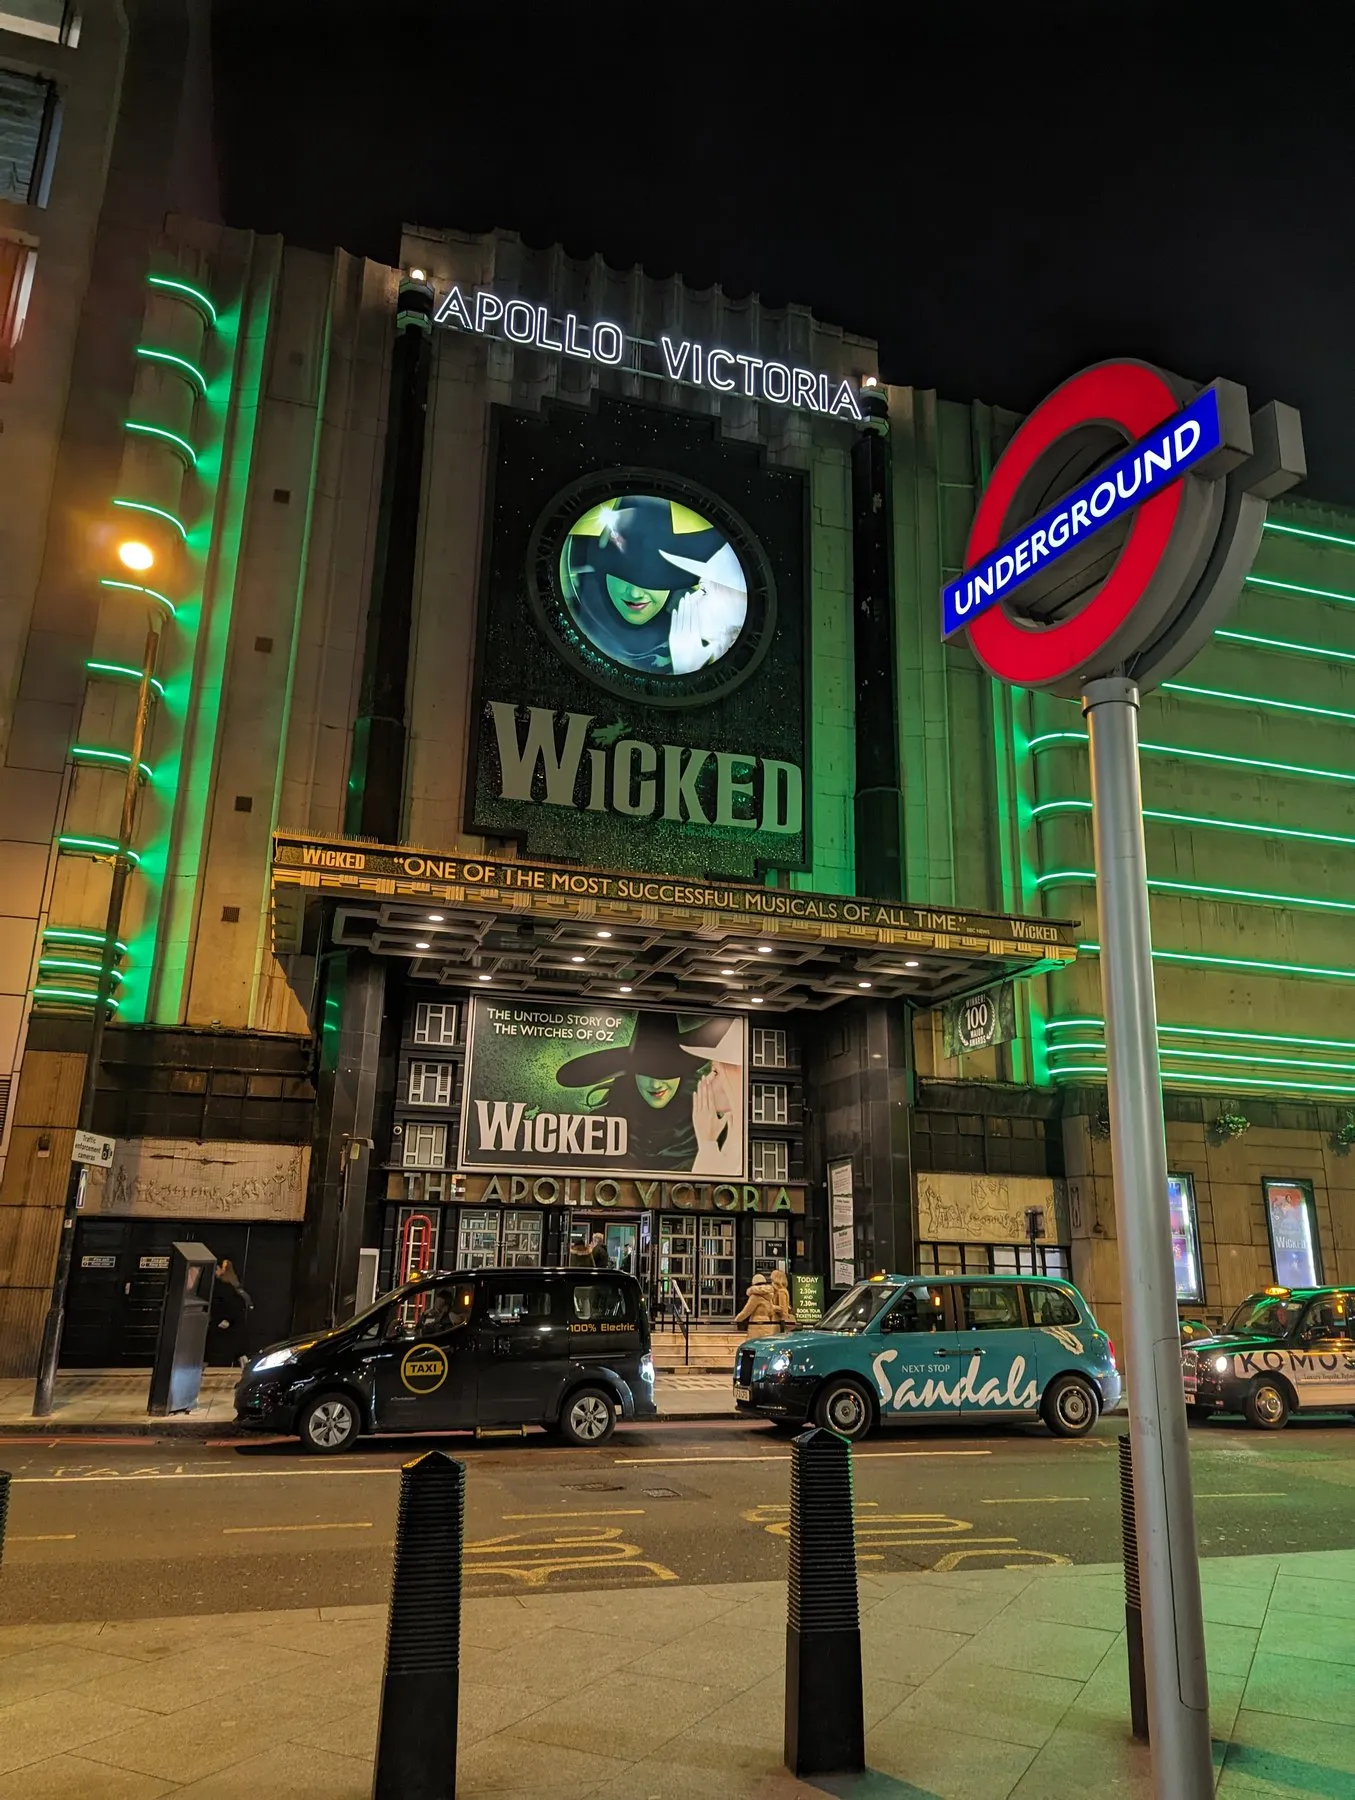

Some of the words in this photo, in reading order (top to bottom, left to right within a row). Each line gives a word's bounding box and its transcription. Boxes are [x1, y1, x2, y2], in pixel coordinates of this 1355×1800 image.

[434, 286, 623, 365] APOLLO
[661, 336, 862, 420] VICTORIA
[954, 420, 1201, 615] UNDERGROUND
[463, 863, 496, 883] OF
[501, 866, 545, 888] THE
[551, 872, 612, 895] MOST
[618, 879, 740, 909] SUCCESSFUL
[745, 893, 838, 920] MUSICALS
[843, 903, 871, 922] OF
[875, 907, 910, 927] ALL
[487, 1007, 511, 1021] THE
[514, 1010, 564, 1025] UNTOLD
[567, 1014, 603, 1028] STORY
[605, 1016, 622, 1028] OF
[965, 1003, 988, 1030] 100
[493, 1022, 517, 1035] THE
[520, 1024, 574, 1039] WITCHES
[576, 1028, 594, 1041] OF
[596, 1029, 614, 1042] OZ
[404, 1172, 467, 1202] THE
[480, 1174, 620, 1207] APOLLO
[634, 1180, 794, 1212] VICTORIA
[569, 1323, 597, 1333] 100%
[600, 1323, 635, 1332] Electric
[410, 1364, 437, 1373] TAXI
[873, 1349, 1042, 1410] Sandals
[901, 1364, 924, 1373] NEXT
[927, 1364, 950, 1373] STOP
